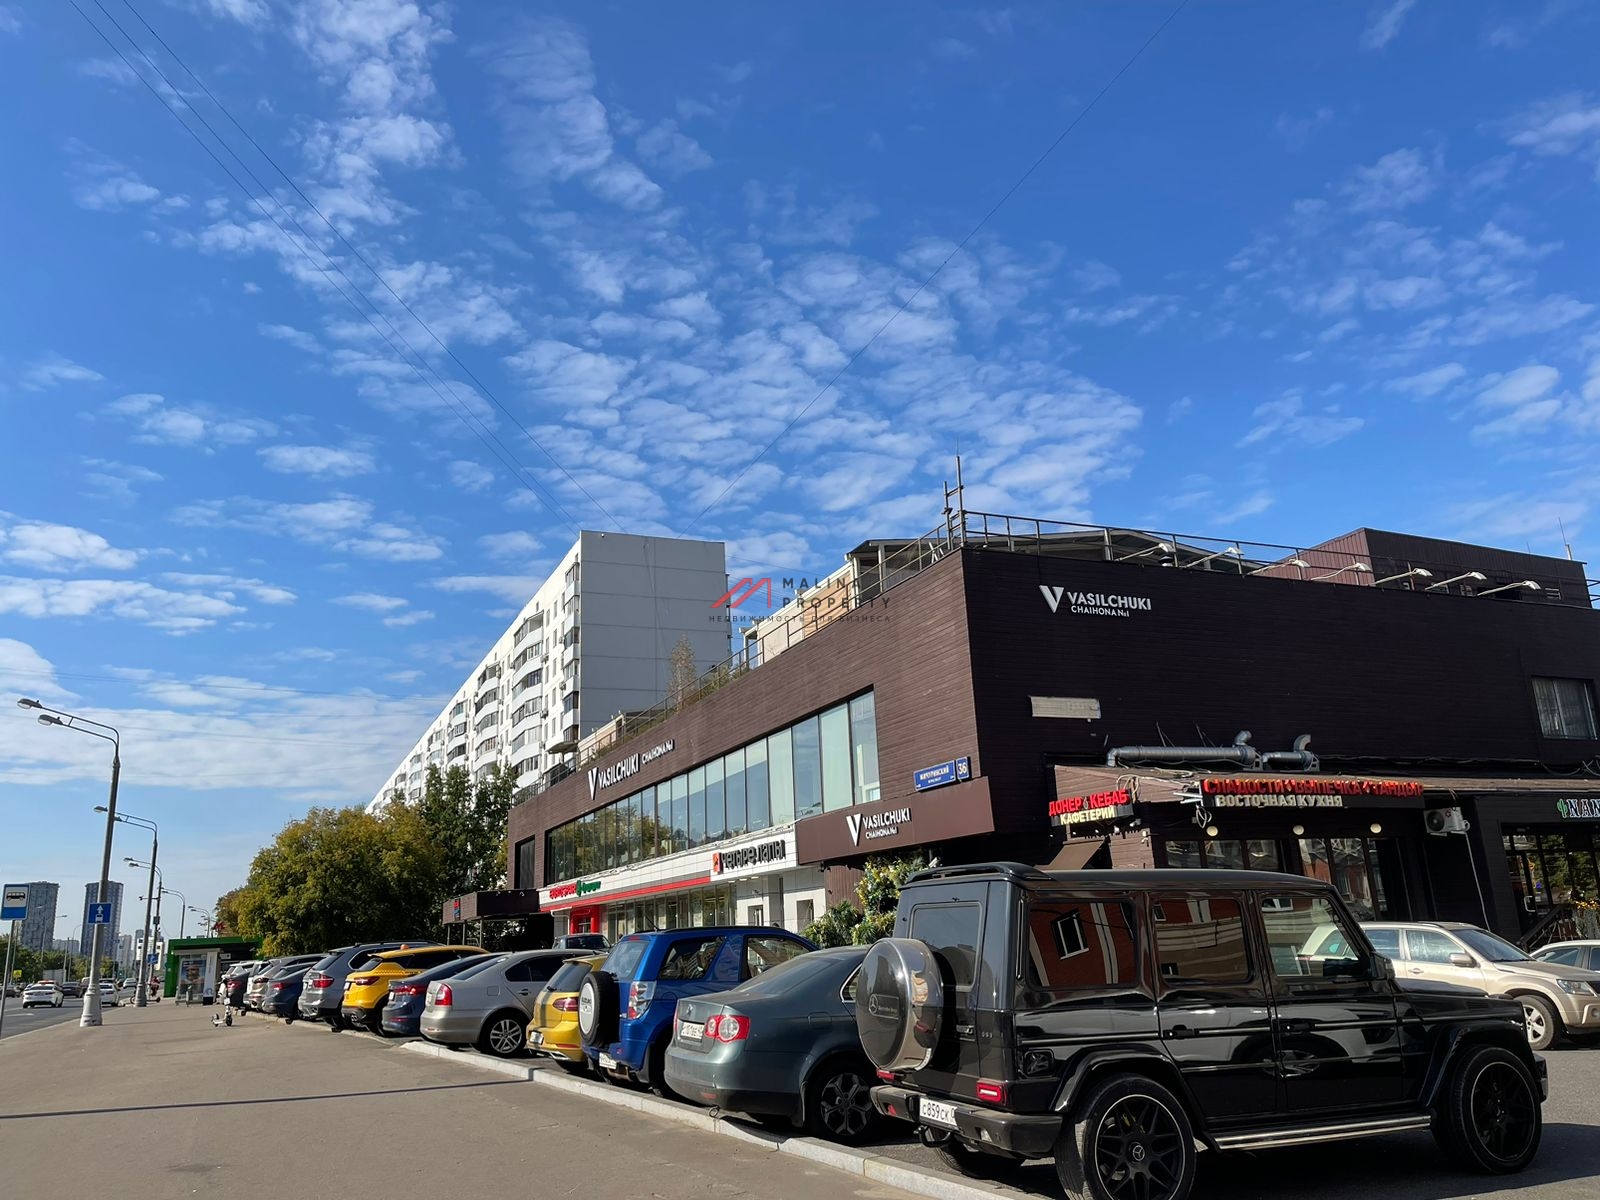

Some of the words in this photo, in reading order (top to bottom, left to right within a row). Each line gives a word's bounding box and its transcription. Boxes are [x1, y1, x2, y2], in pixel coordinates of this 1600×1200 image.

[1067, 591, 1152, 610] VASILCHUKI
[1071, 605, 1117, 616] CHAIHONA
[598, 753, 639, 789] VASILCHUKI
[957, 762, 968, 775] 36
[1203, 779, 1285, 794] СЛАДОСТИ
[1295, 779, 1362, 795] ВЫПЕЧКА
[1373, 781, 1424, 797] ТАНДЫР
[1049, 797, 1082, 816] ДОНЕР
[1089, 788, 1129, 808] КЕБАБ
[1214, 794, 1297, 807] ВОСТОЧНАЯ
[1297, 794, 1343, 807] КУХНЯ
[862, 808, 911, 829] VASILCHUKI
[1060, 805, 1117, 825] КАФЕТЕРИЙ
